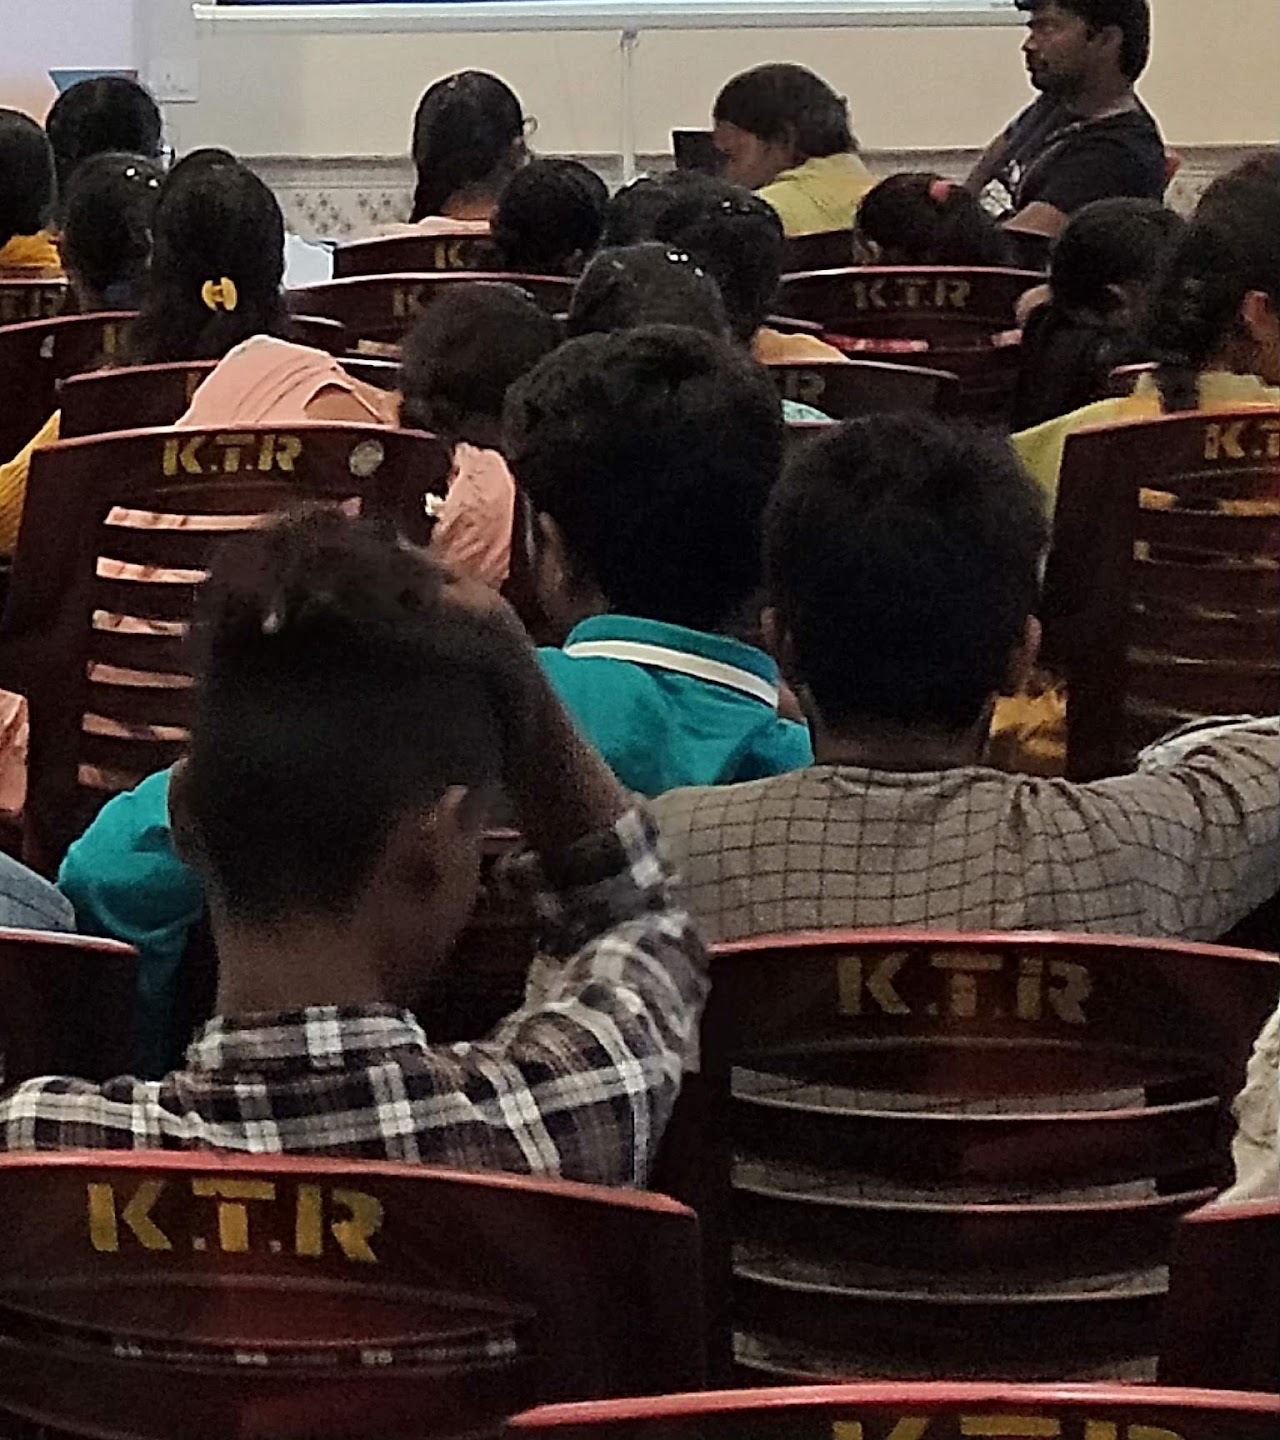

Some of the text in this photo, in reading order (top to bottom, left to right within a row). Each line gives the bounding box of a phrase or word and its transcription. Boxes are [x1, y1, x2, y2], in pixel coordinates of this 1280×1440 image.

[851, 277, 971, 310] K.T.R
[162, 433, 303, 476] K.T.R
[1203, 420, 1280, 461] K.T
[836, 951, 1095, 1024] K.T.R
[86, 1176, 387, 1263] K.T.R
